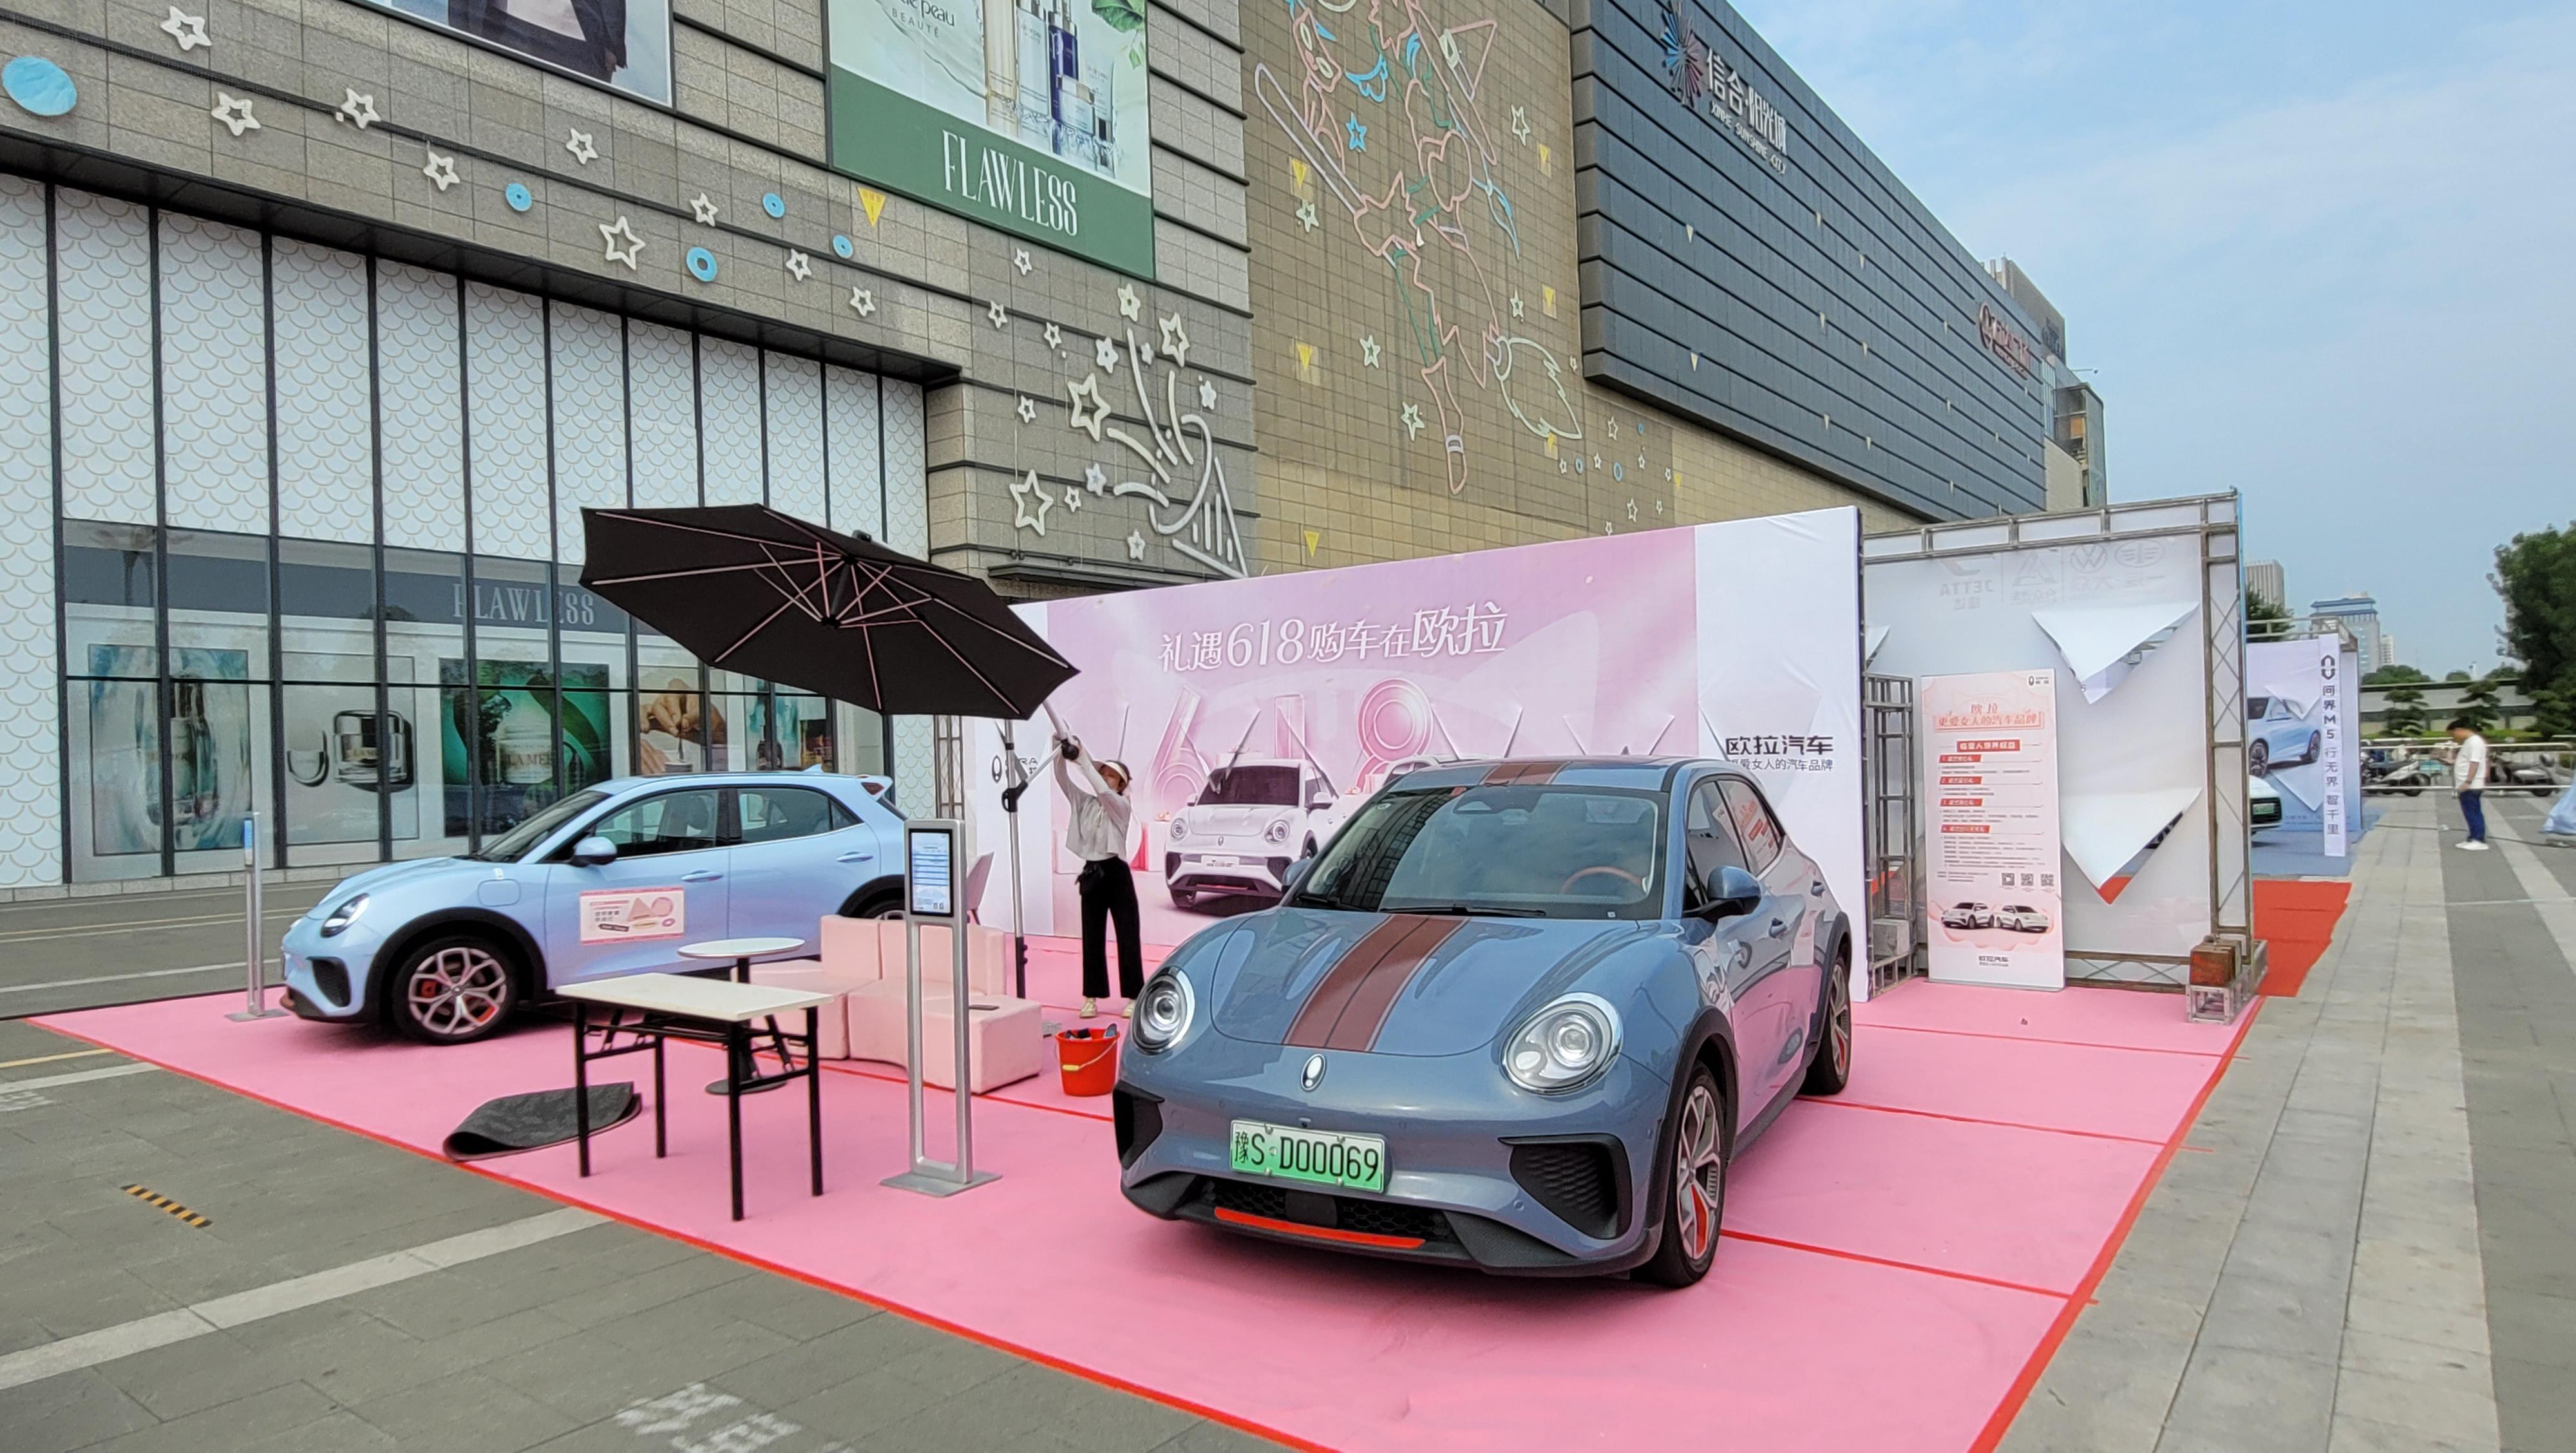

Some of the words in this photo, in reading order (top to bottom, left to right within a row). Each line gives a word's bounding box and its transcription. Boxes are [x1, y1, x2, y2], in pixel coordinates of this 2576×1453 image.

[891, 8, 939, 37] BEAUTÉ
[921, 0, 954, 26] peau
[1710, 101, 1732, 128] XINHE
[1734, 122, 1768, 160] SUNSHINE
[1770, 154, 1786, 175] CITY
[942, 129, 1078, 236] FLAWLESS
[453, 584, 594, 625] FLAWLSS
[1158, 601, 1508, 672] 礼遇618购车在欧拉
[1725, 735, 1833, 755] 欧拉汽车
